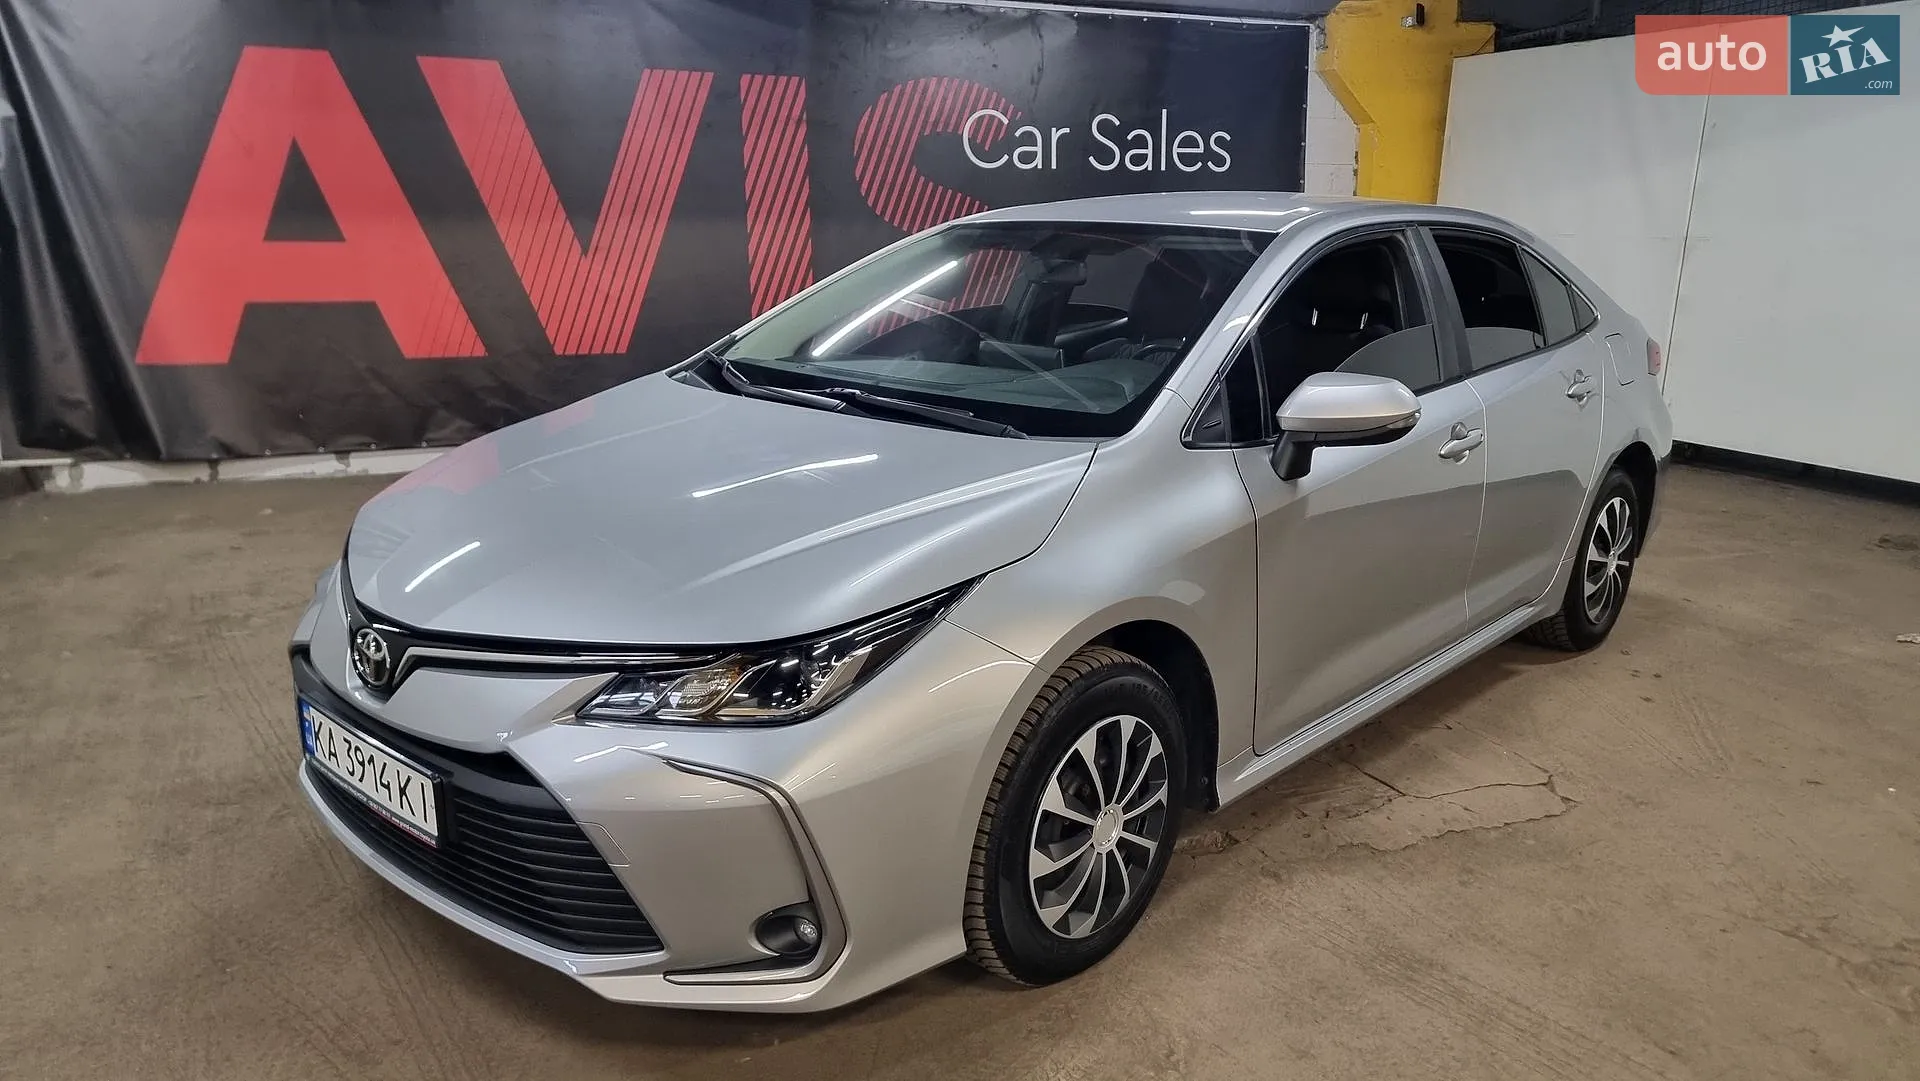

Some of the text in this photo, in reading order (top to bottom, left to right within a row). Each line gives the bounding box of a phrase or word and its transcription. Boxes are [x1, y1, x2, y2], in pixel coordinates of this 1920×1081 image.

[962, 108, 1232, 173] Car Sales
[136, 46, 1023, 365] AVIS
[311, 715, 341, 768] KA
[343, 736, 393, 803] 3914
[396, 769, 429, 824] KI
